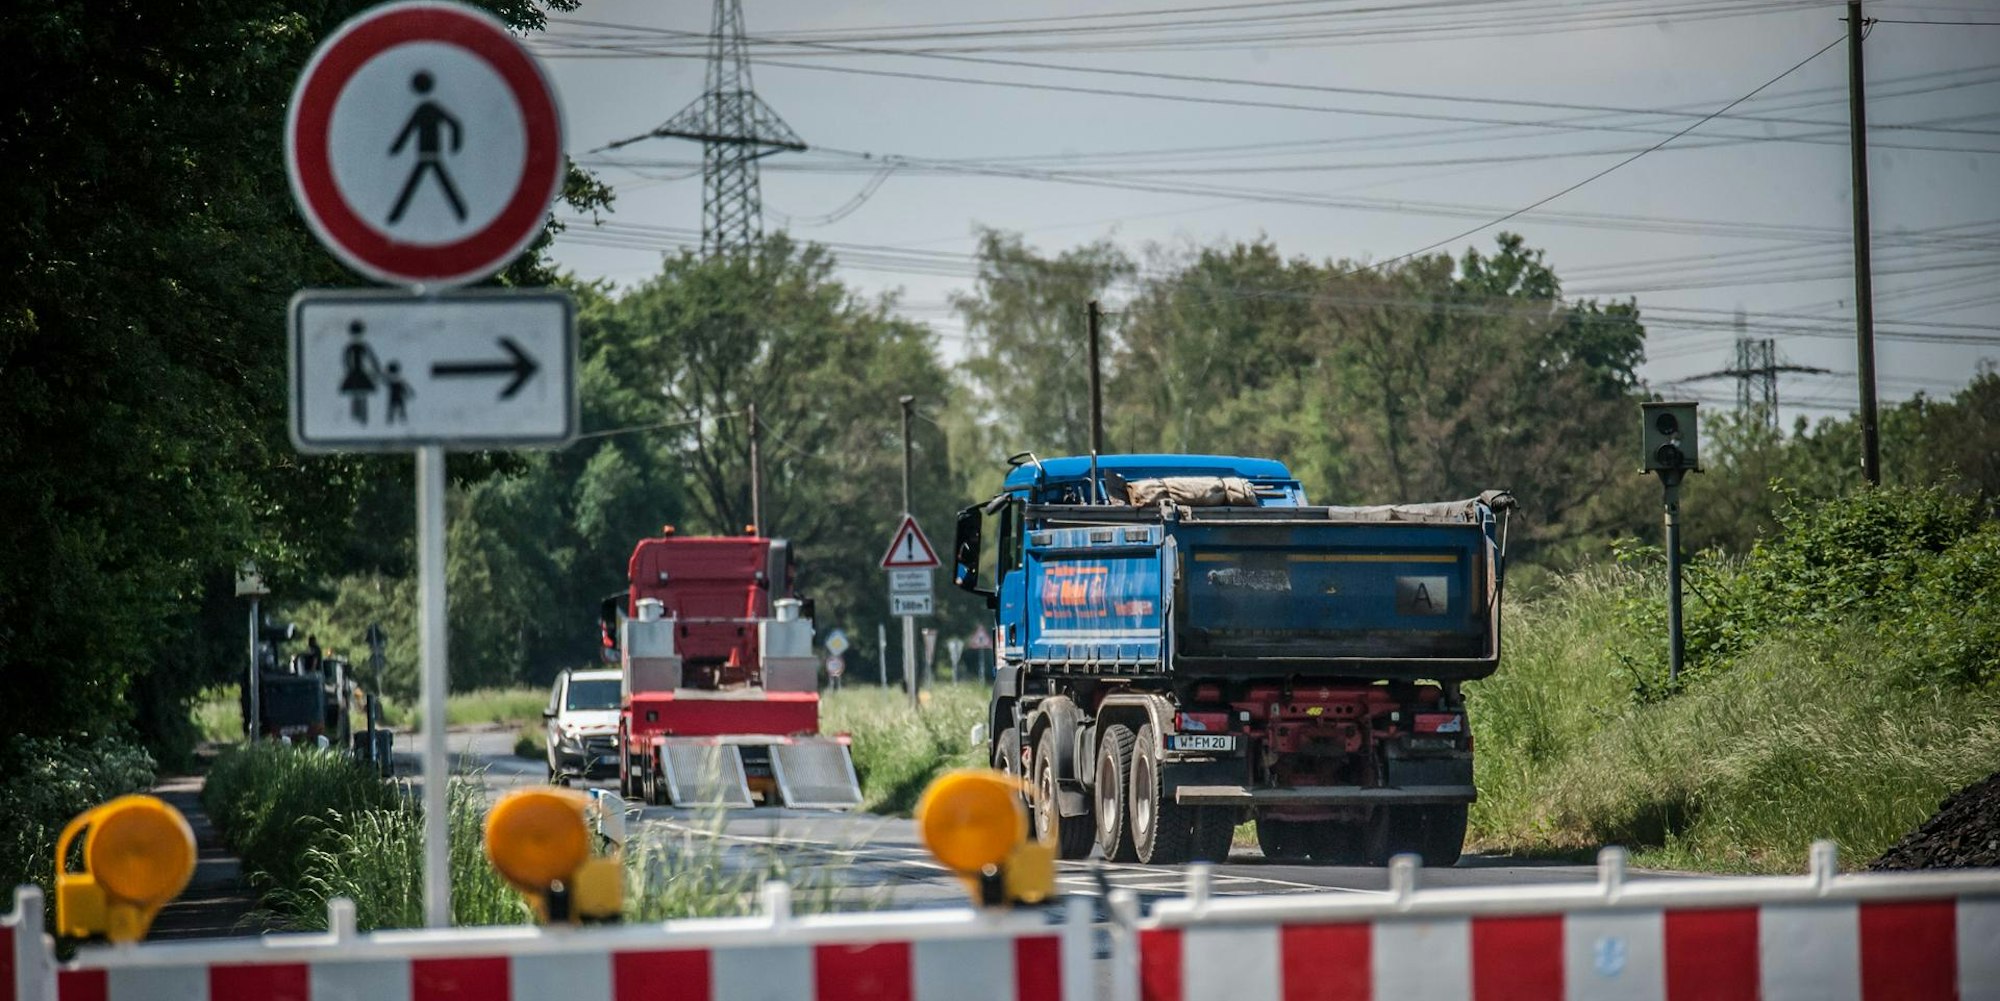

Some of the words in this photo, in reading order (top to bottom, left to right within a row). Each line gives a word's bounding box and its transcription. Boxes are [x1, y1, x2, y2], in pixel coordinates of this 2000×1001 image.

[1411, 582, 1433, 609] A
[1195, 737, 1210, 748] FM
[1212, 737, 1226, 748] 20
